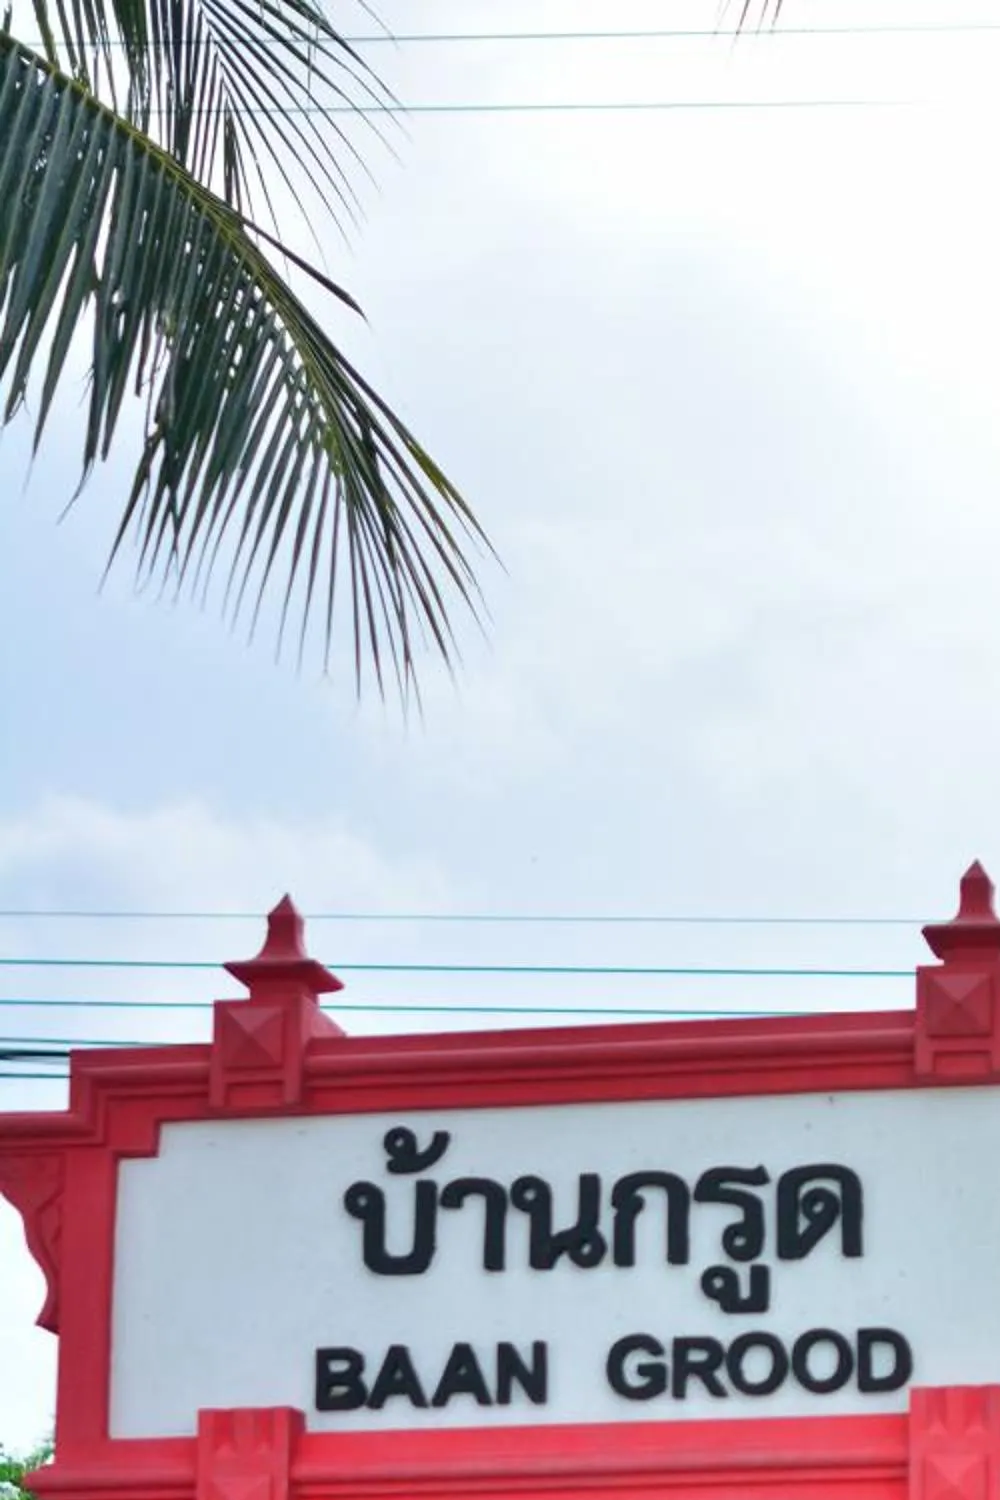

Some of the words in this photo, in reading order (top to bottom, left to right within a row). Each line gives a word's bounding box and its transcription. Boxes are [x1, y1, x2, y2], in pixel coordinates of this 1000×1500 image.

[344, 1126, 863, 1314] บ้านกรูด
[315, 1341, 547, 1412] BAAN
[606, 1328, 913, 1401] GROOD
